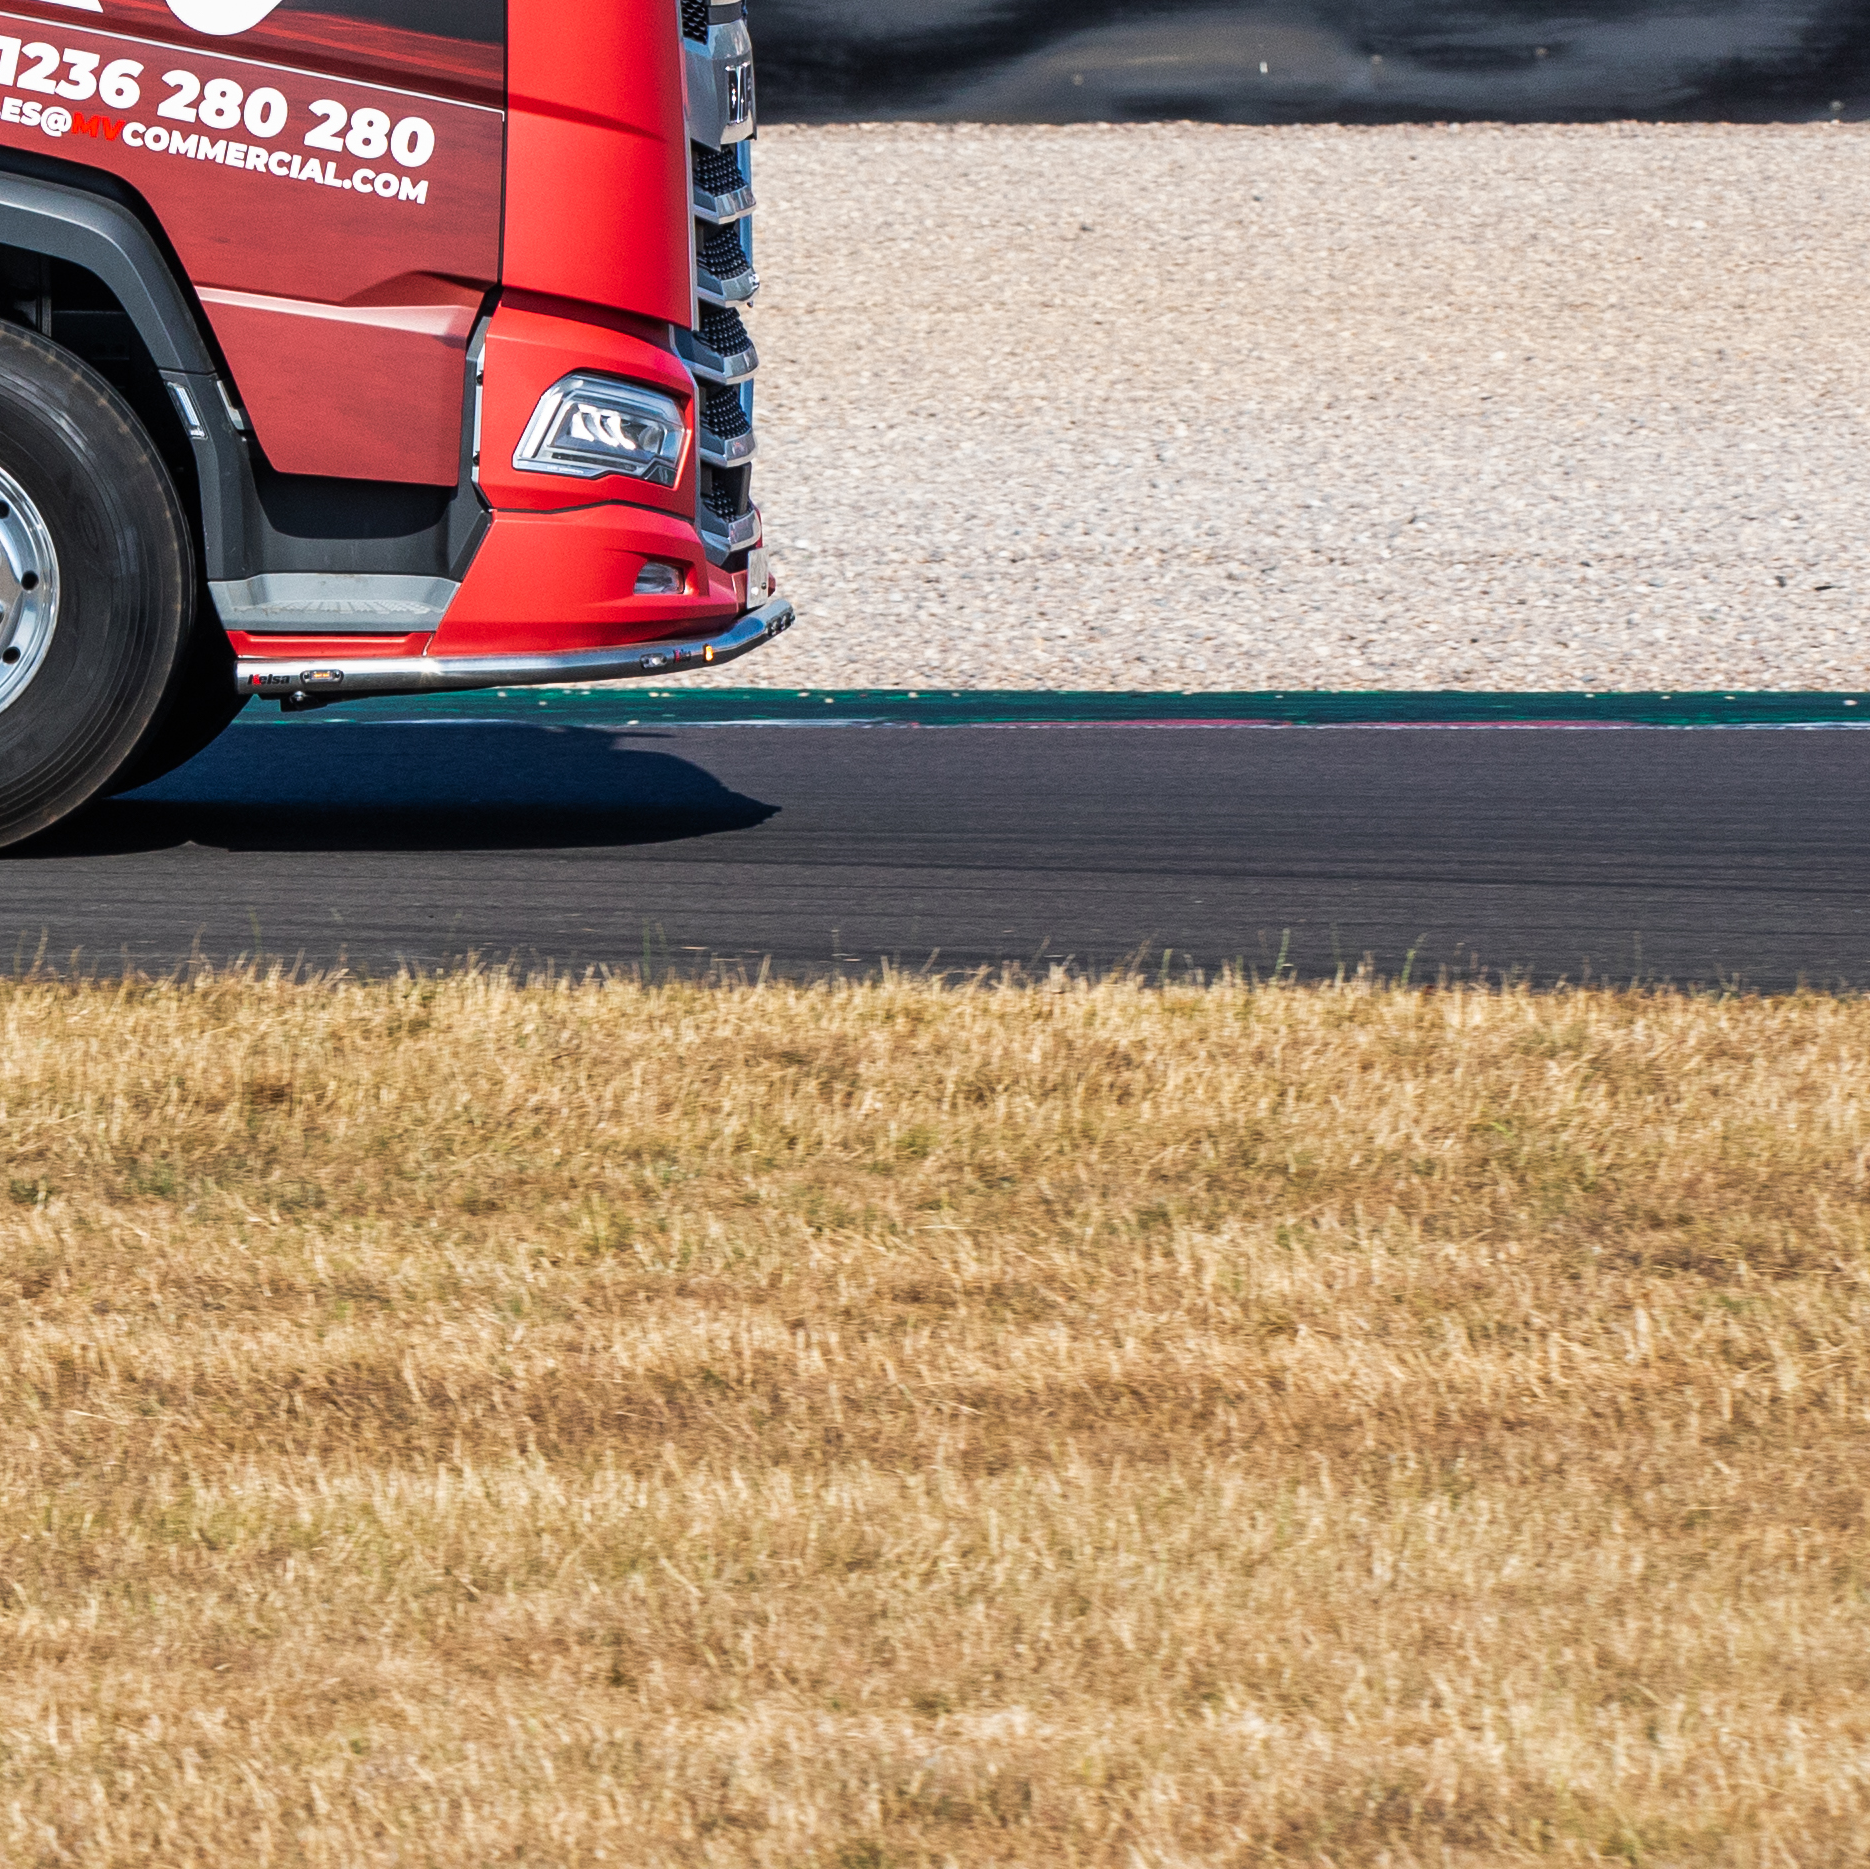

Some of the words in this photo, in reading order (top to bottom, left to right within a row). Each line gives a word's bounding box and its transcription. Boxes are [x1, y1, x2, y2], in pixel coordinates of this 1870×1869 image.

[156, 69, 288, 138] 280
[303, 98, 436, 168] 280
[247, 673, 290, 685] Kelsa
